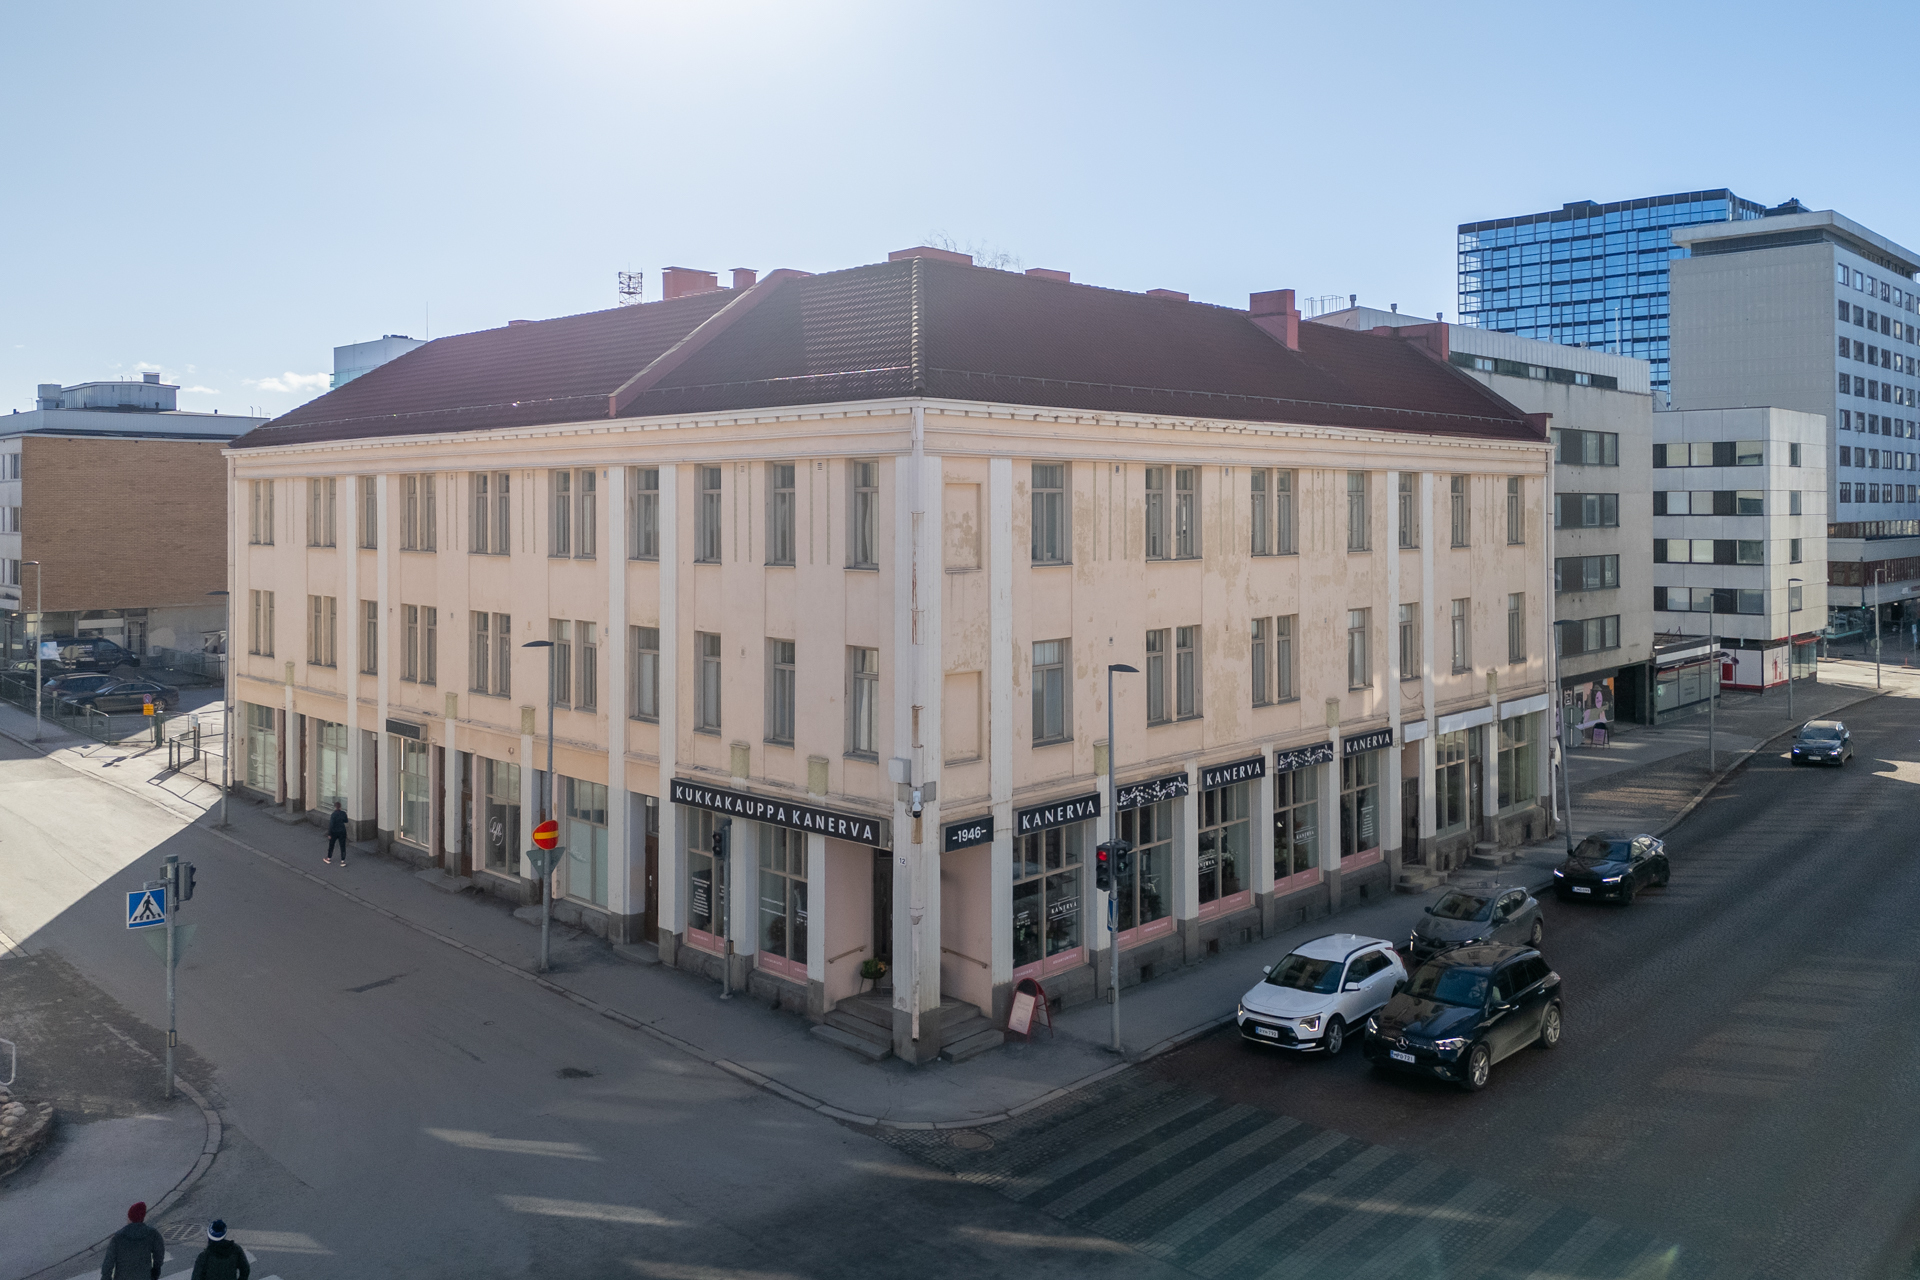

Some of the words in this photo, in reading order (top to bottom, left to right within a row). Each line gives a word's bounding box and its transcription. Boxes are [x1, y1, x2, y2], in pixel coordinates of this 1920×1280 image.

[1346, 733, 1390, 753] KANERVA
[1206, 762, 1261, 786] KANERVA
[676, 785, 786, 822] KUKKAKAUPPA
[792, 810, 873, 841] KANERVA
[1022, 800, 1095, 830] KANERVA
[899, 857, 906, 865] 12
